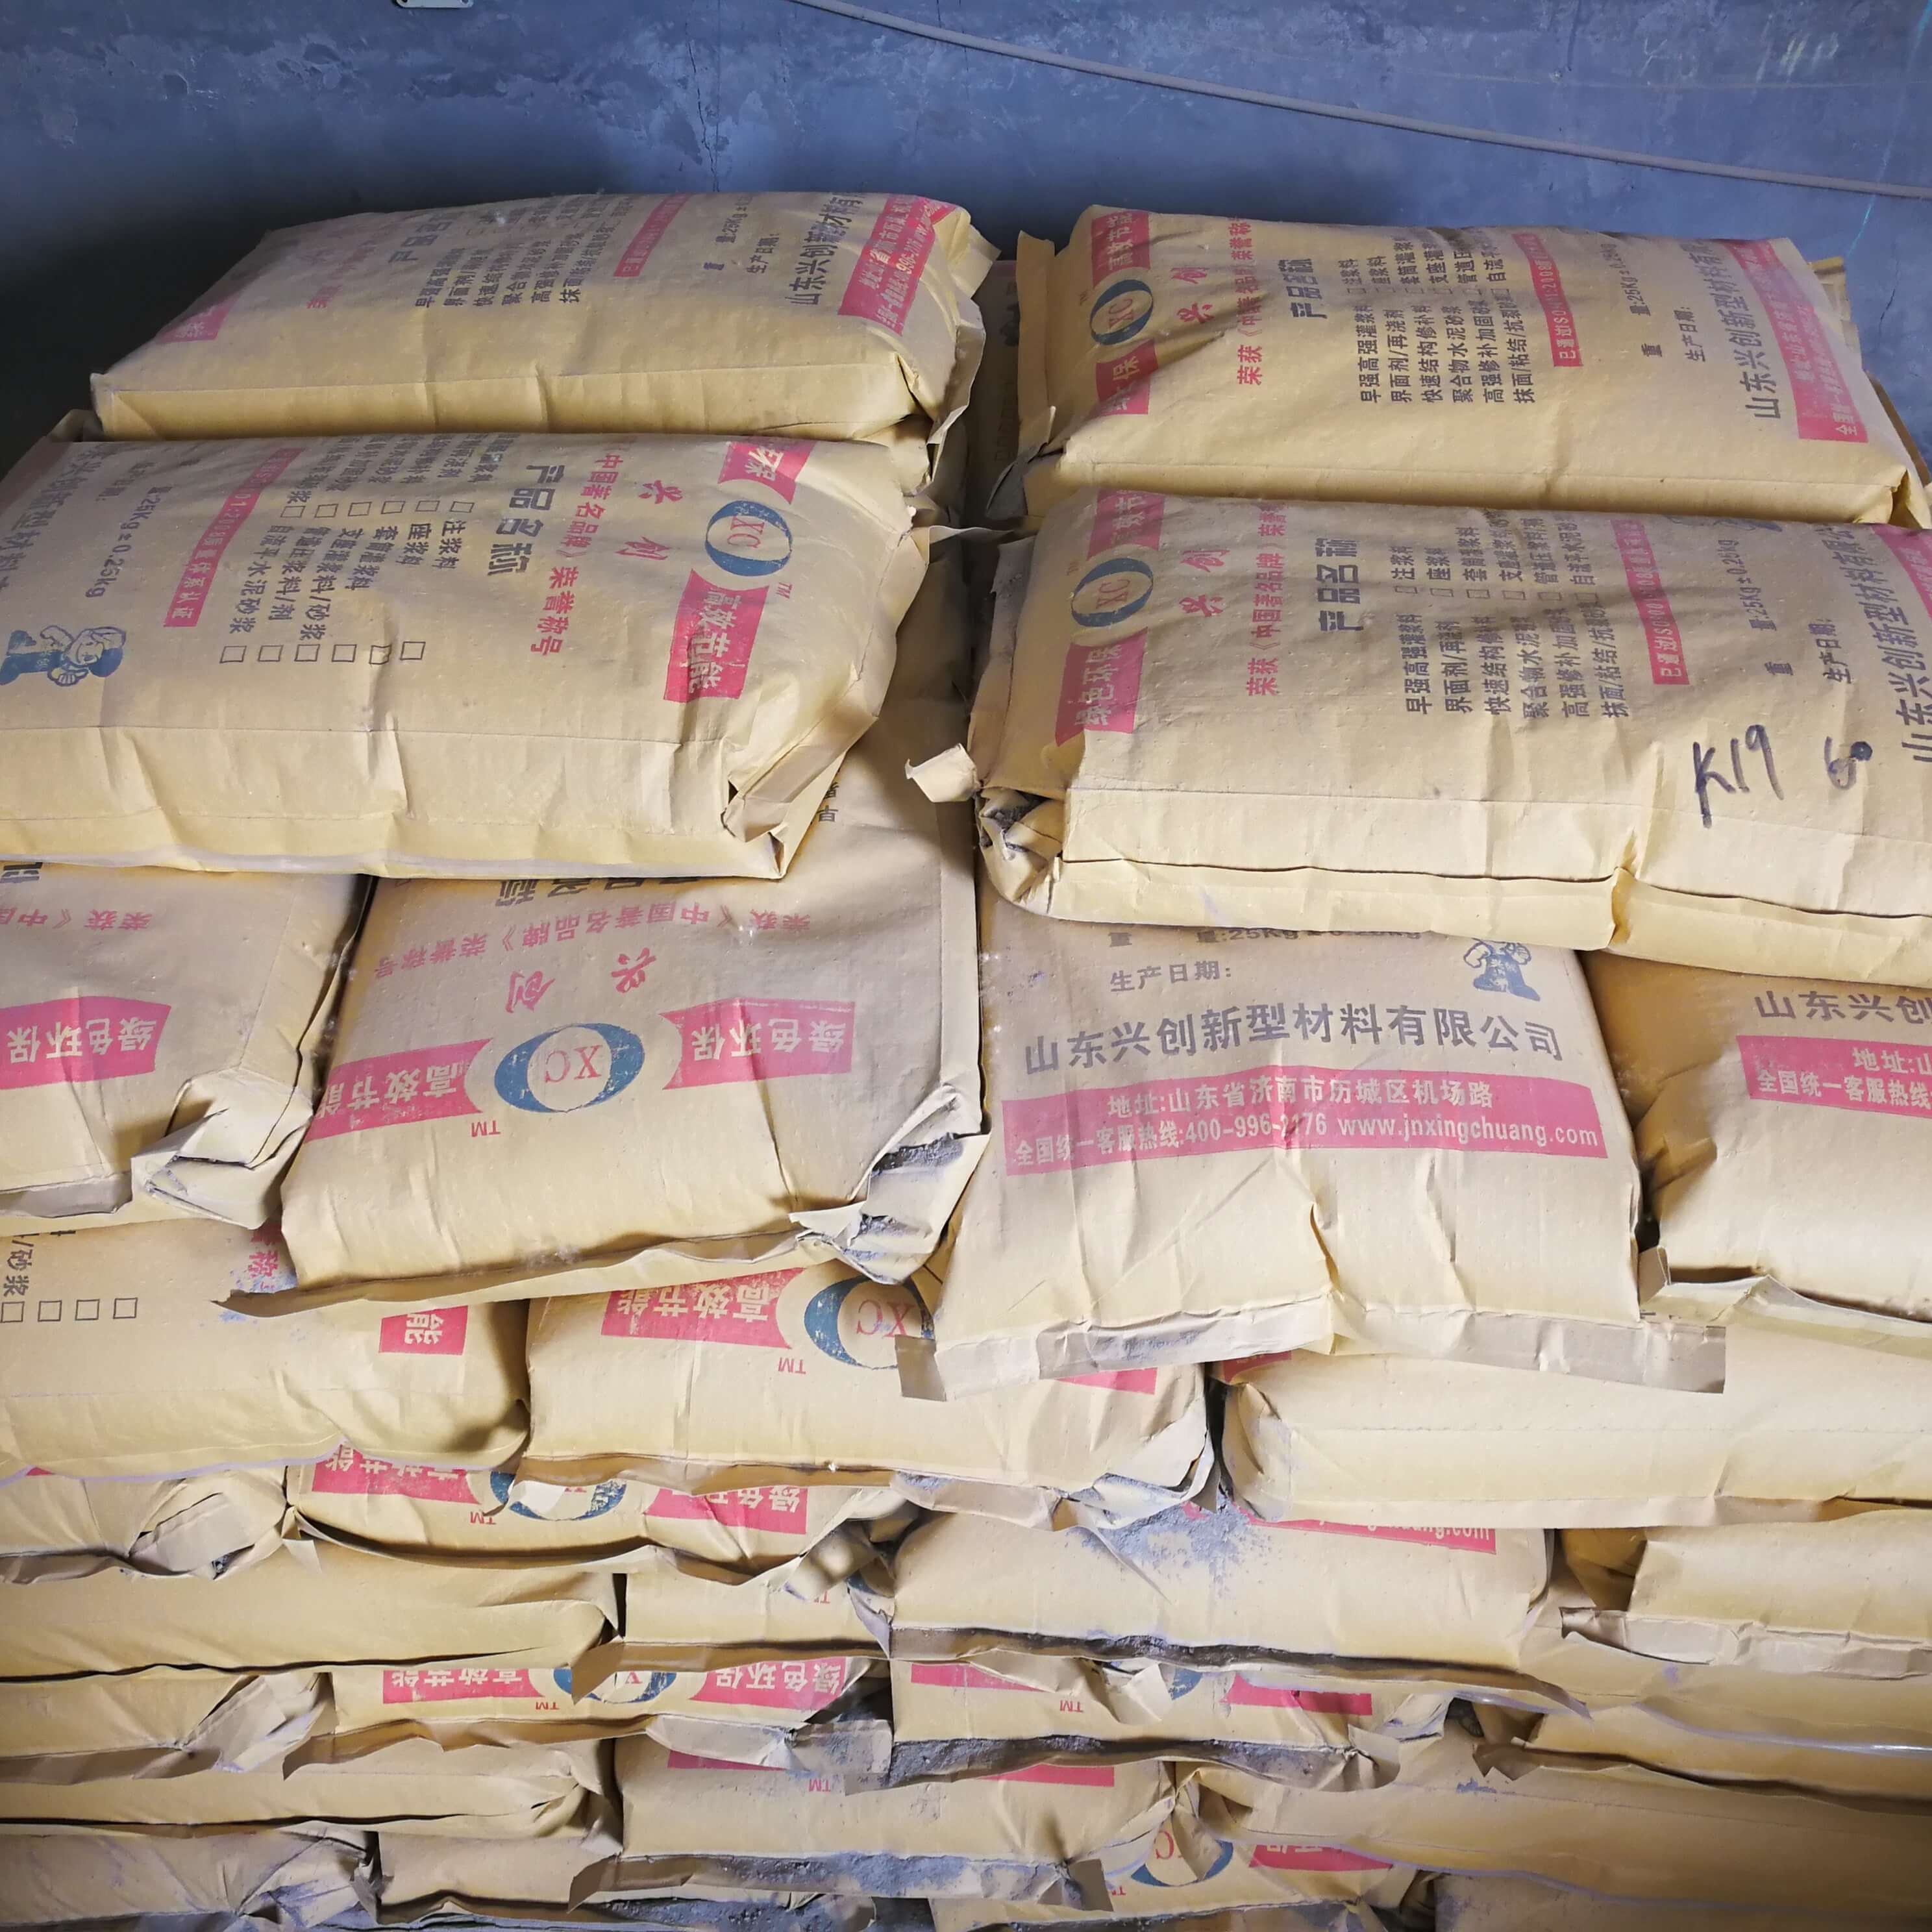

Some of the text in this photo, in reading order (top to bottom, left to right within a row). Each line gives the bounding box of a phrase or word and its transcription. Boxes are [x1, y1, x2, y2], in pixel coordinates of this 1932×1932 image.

[1672, 307, 1706, 363] 生产日期:
[486, 464, 563, 576] 产品名称
[398, 523, 432, 566] 座浆料
[433, 521, 465, 569] 注浆料
[229, 525, 293, 634] 自流平水泥砂浆
[1313, 538, 1364, 632] 产品名称
[687, 589, 742, 695] 高效节能
[1809, 618, 1852, 685] 生产日期:
[1765, 661, 1794, 676] 重
[1692, 724, 1785, 829] K19
[1108, 932, 1133, 948] 重
[1110, 961, 1232, 993] 生产日期:
[6, 1017, 158, 1065] 绿色环保
[691, 1018, 846, 1061] 绿色环保
[1025, 1002, 1563, 1074] 山东兴创新型材料有限公司
[544, 1044, 604, 1084] XC
[1107, 1074, 1494, 1119] 地址:山东省济南市历城区机场路
[471, 1120, 501, 1138] TM
[1338, 1114, 1599, 1147] www.jnxingchuang.com
[617, 1285, 770, 1324] 高效节能
[778, 1356, 807, 1375] TM
[535, 1701, 560, 1711] TM
[1059, 1700, 1083, 1713] TM
[808, 1778, 832, 1792] TM
